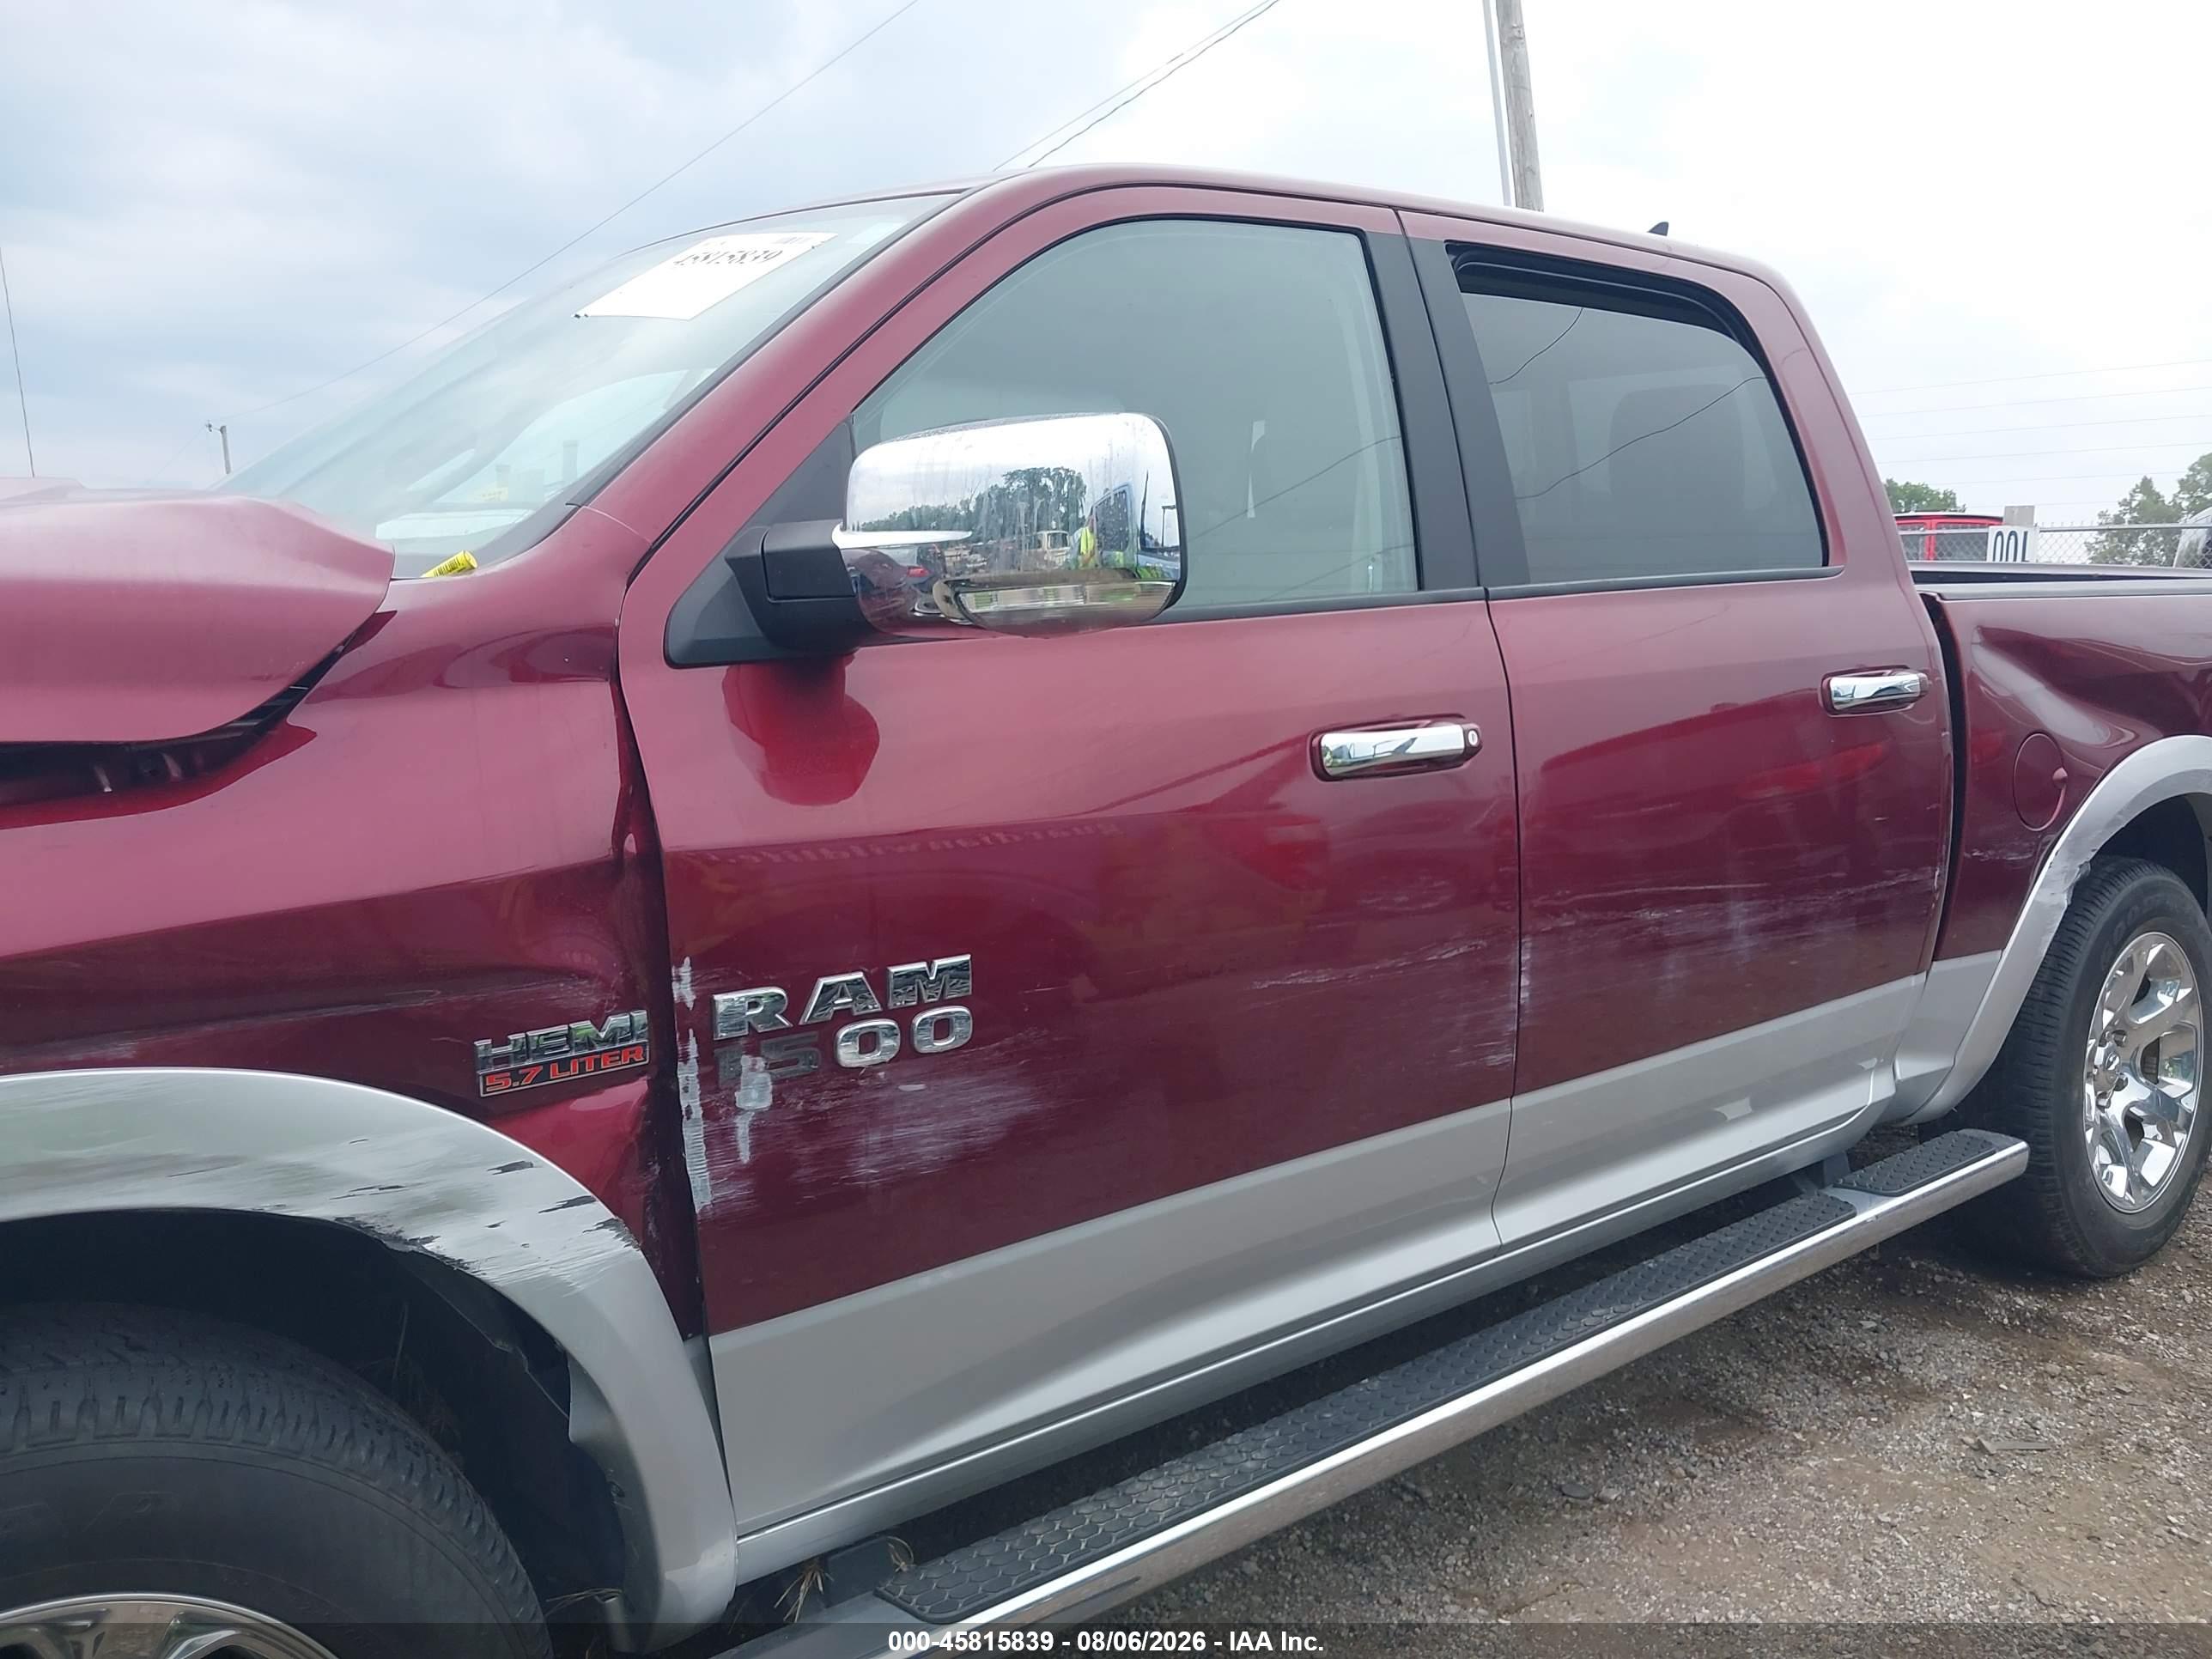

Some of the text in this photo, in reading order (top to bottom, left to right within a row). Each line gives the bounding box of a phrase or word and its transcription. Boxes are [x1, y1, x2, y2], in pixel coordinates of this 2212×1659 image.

[713, 953, 972, 1041] RAM
[473, 1009, 648, 1072] HEMI
[485, 1044, 644, 1092] 5.7 LITER
